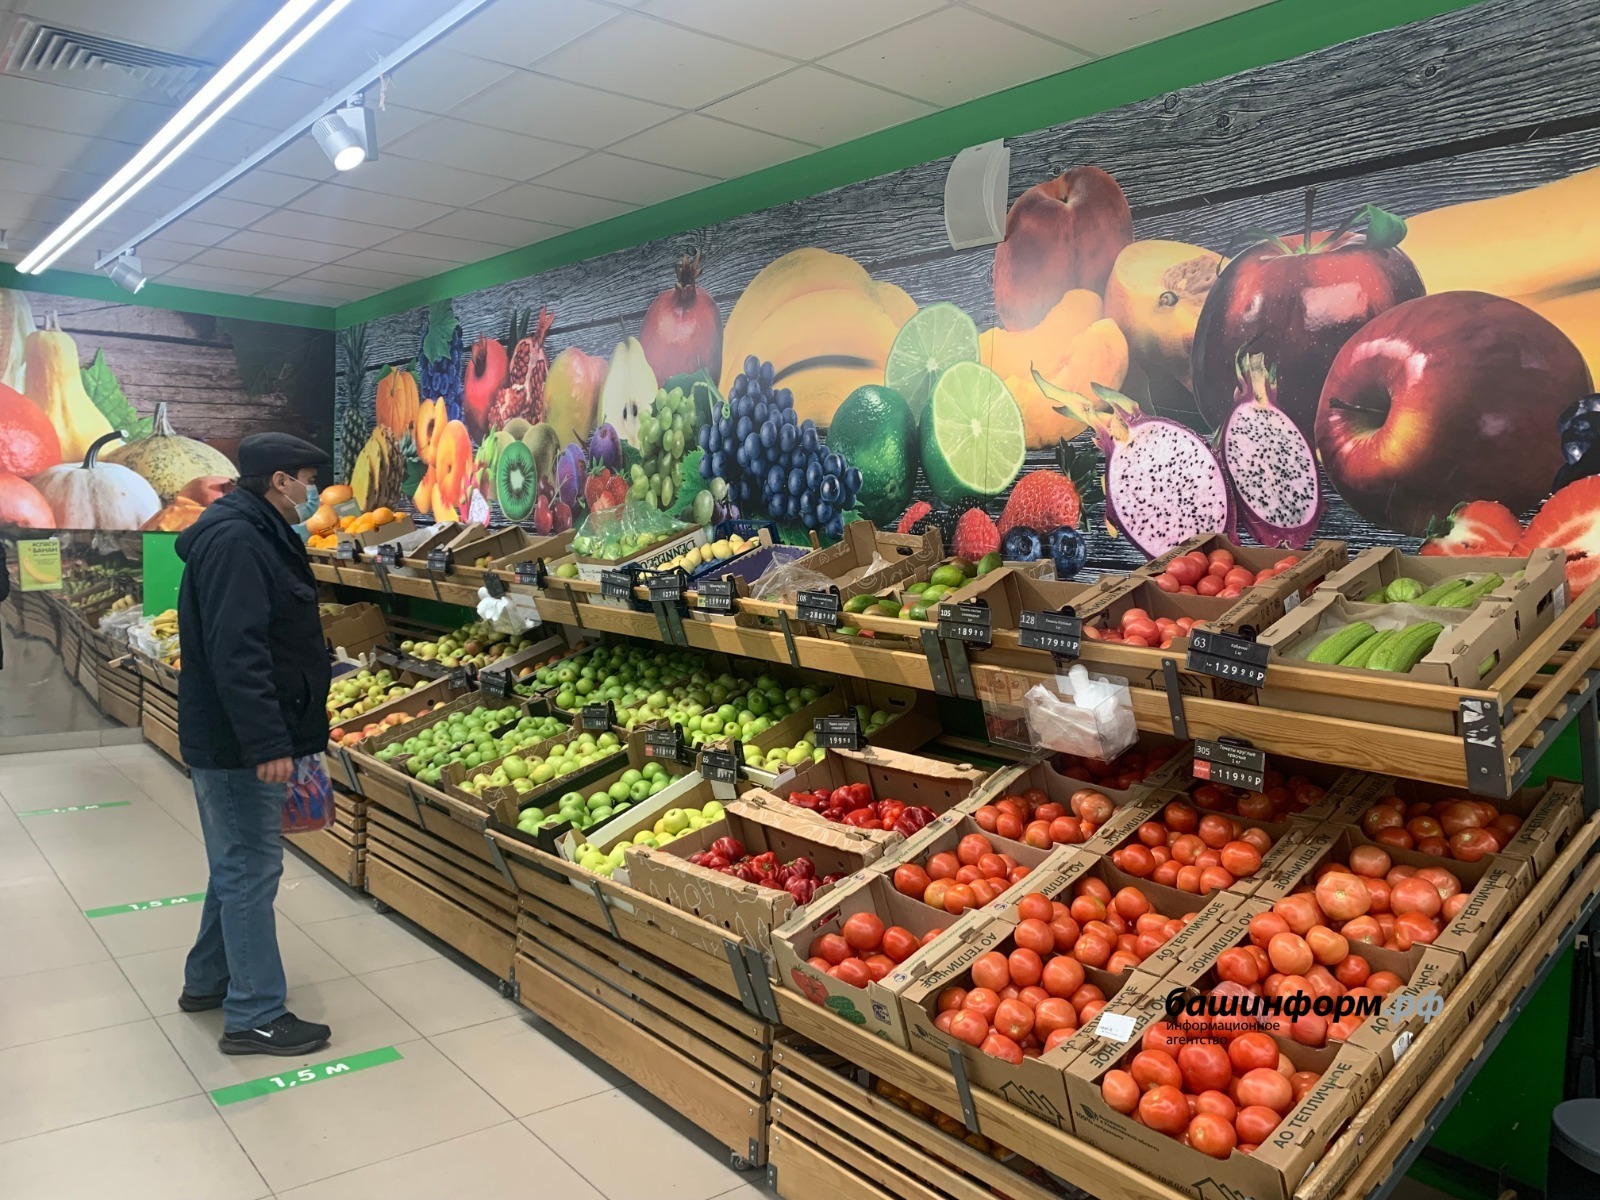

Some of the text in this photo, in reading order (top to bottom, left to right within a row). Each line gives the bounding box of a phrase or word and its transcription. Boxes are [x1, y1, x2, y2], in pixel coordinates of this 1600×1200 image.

[940, 608, 951, 618] 105
[1020, 614, 1035, 625] 128
[1193, 636, 1206, 648] 63
[1196, 745, 1211, 756] 305
[1273, 844, 1322, 891] ТЕПЛИЧНОЕ
[128, 900, 163, 911] 1,5
[1169, 901, 1225, 948] ТЕПЛИЧНОЕ
[982, 932, 998, 947] АО
[1186, 926, 1244, 974] ТЕПЛИЧНОЕ
[269, 1069, 316, 1089] 1,5
[1272, 1130, 1294, 1149] АО
[1288, 1061, 1353, 1131] ТЕПЛИЧНОЕ
